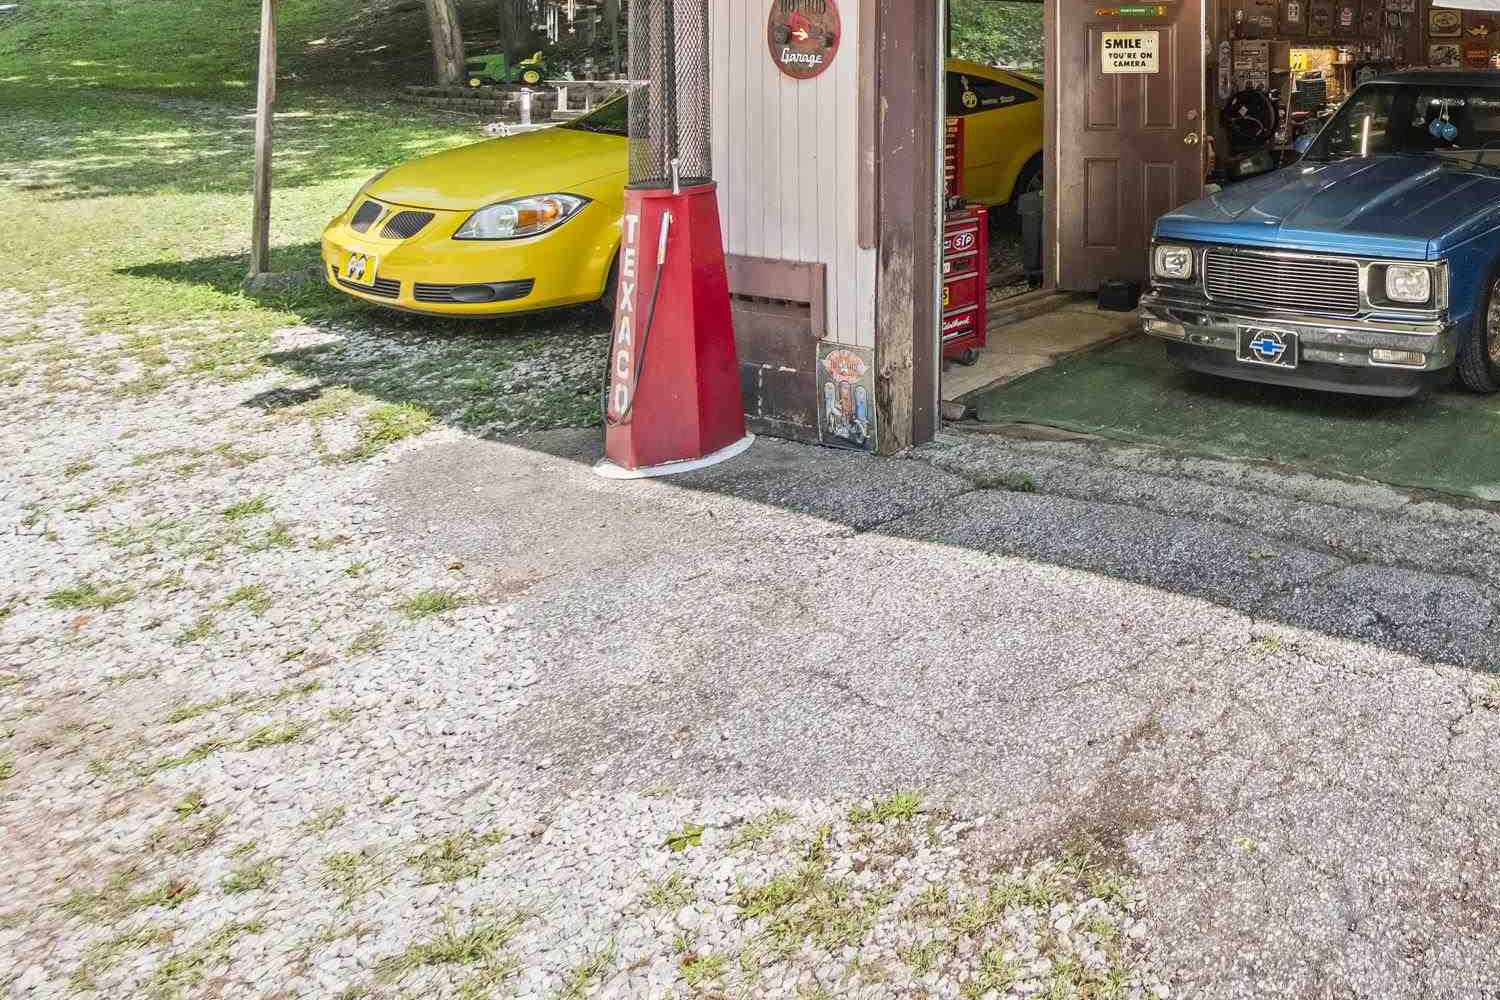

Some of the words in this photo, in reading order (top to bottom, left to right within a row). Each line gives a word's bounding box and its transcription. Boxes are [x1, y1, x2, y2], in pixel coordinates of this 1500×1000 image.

[1105, 38, 1142, 49] SMILE
[781, 47, 823, 68] Garage
[955, 233, 973, 248] STP
[612, 213, 639, 416] TEXACO
